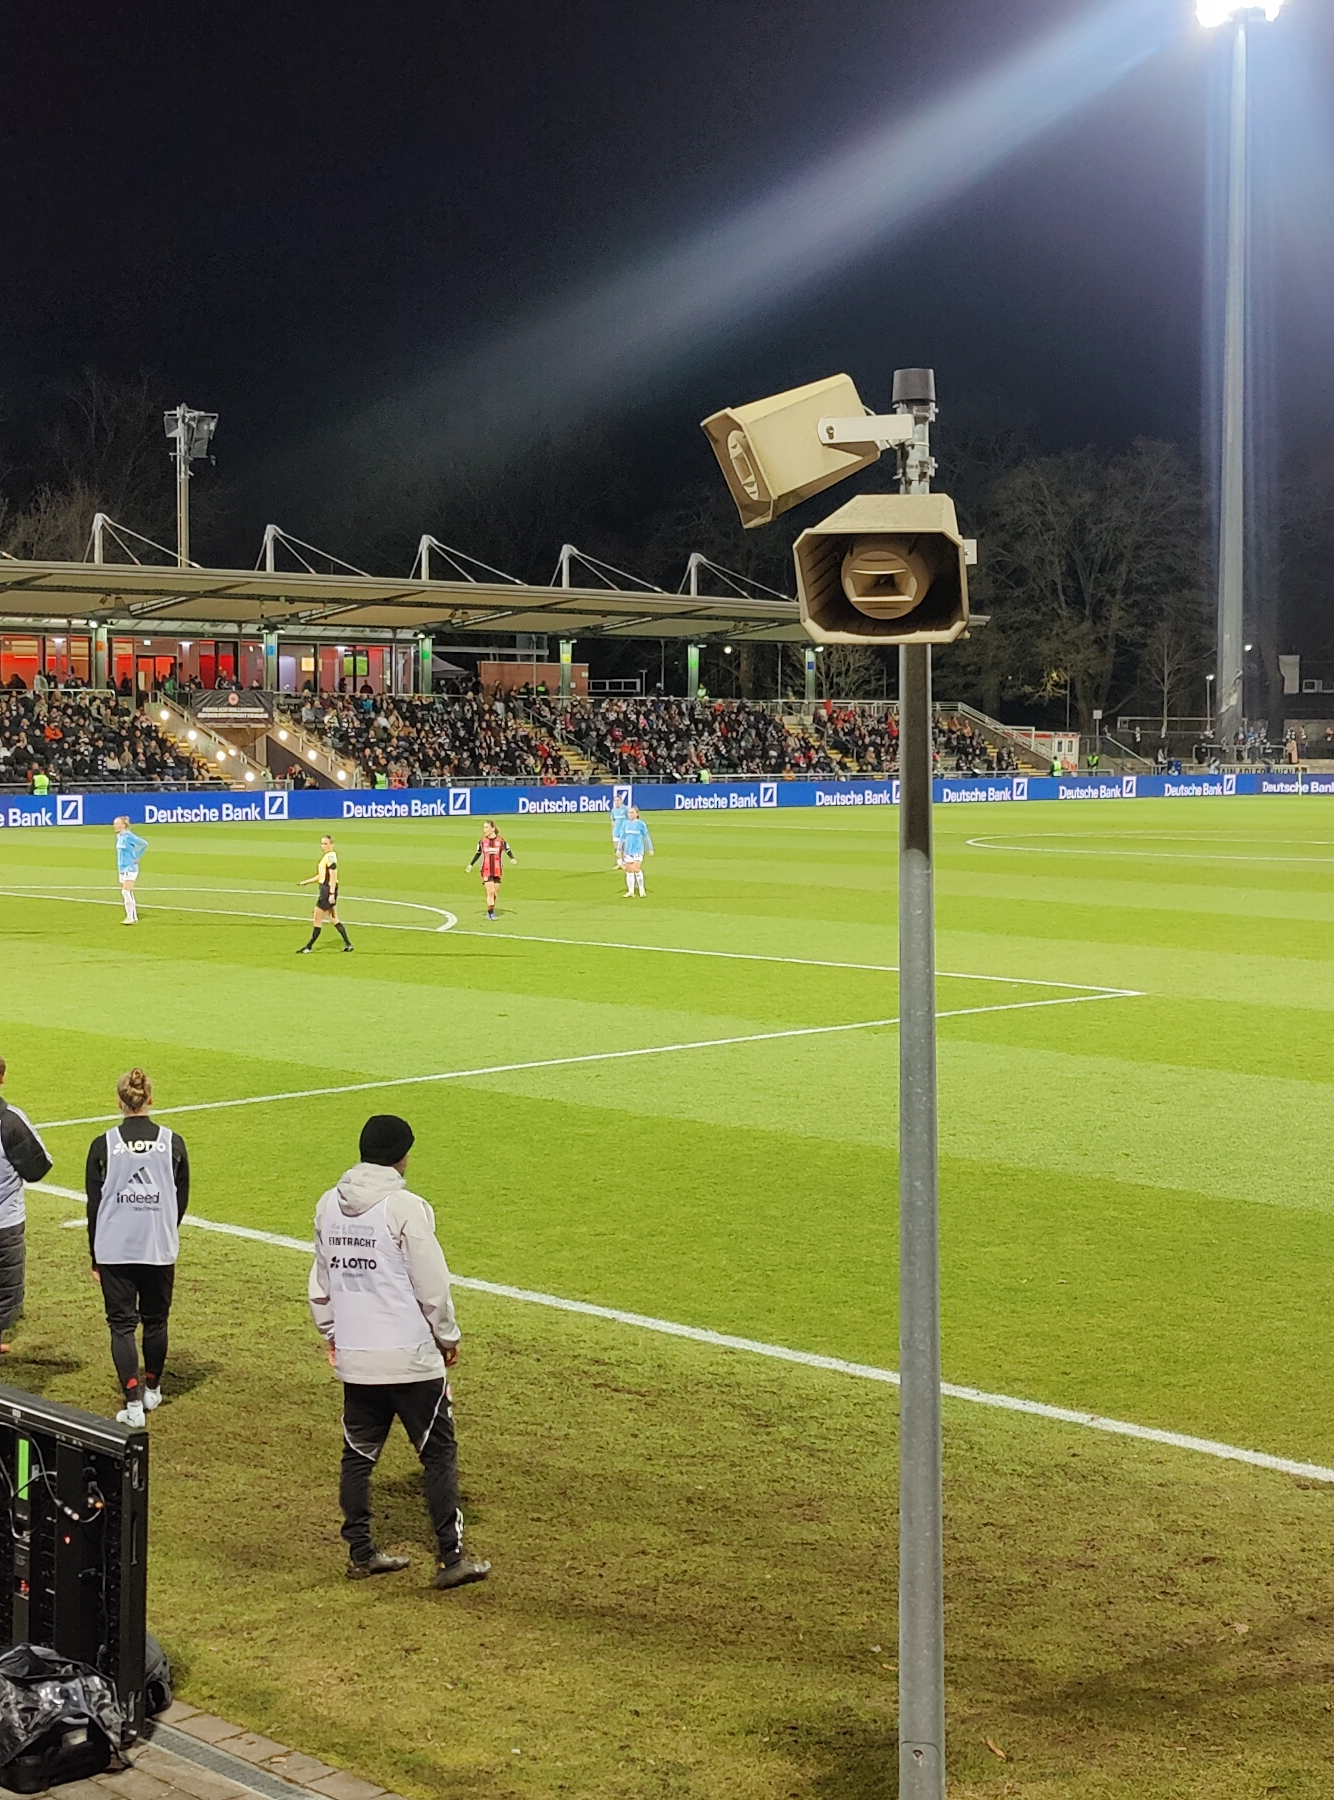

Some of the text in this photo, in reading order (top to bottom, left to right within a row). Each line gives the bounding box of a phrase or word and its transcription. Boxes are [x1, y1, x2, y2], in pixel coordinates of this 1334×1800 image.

[942, 787, 1012, 802] Deutsche Bank
[1059, 784, 1122, 800] Deutsche Bank
[1164, 782, 1223, 797] Deutsche Bank
[518, 796, 611, 813] Deutsche Bank
[675, 792, 758, 810] Deutsche Bank
[815, 790, 891, 806] Deutsche Bank
[144, 803, 262, 823] Deutsche Bank
[343, 799, 447, 818] Deutsche Bank
[8, 808, 53, 827] Bank
[127, 1140, 166, 1152] LOTTO
[116, 1191, 160, 1205] indeed
[328, 1237, 377, 1248] EINTRACHT
[342, 1257, 377, 1270] LOTTO
